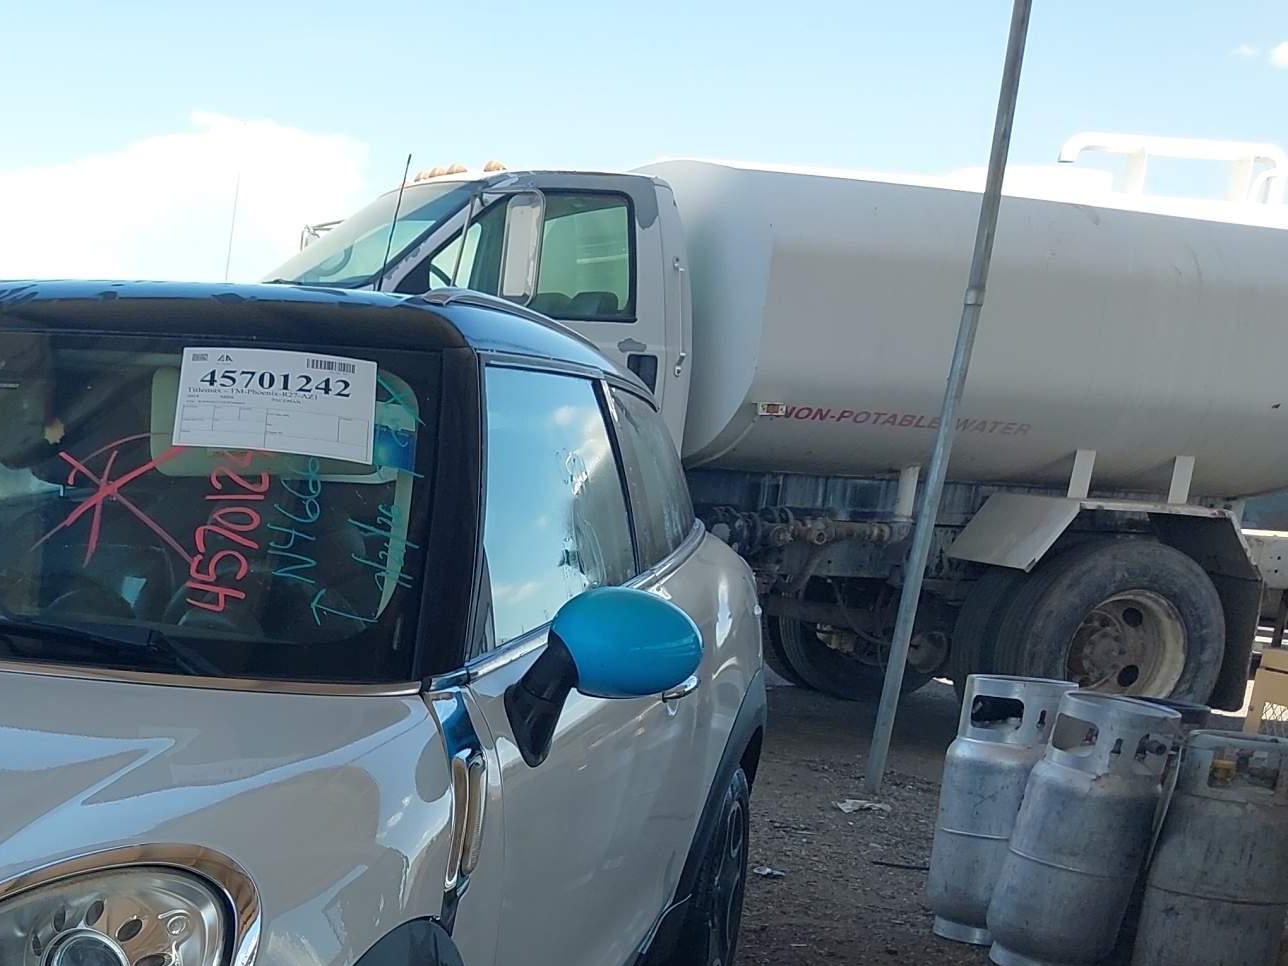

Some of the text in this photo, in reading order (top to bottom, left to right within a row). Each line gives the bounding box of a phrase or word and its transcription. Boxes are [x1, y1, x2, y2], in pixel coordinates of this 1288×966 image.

[199, 368, 352, 398] 45701242
[783, 405, 1032, 436] NON-POTABLE WATER
